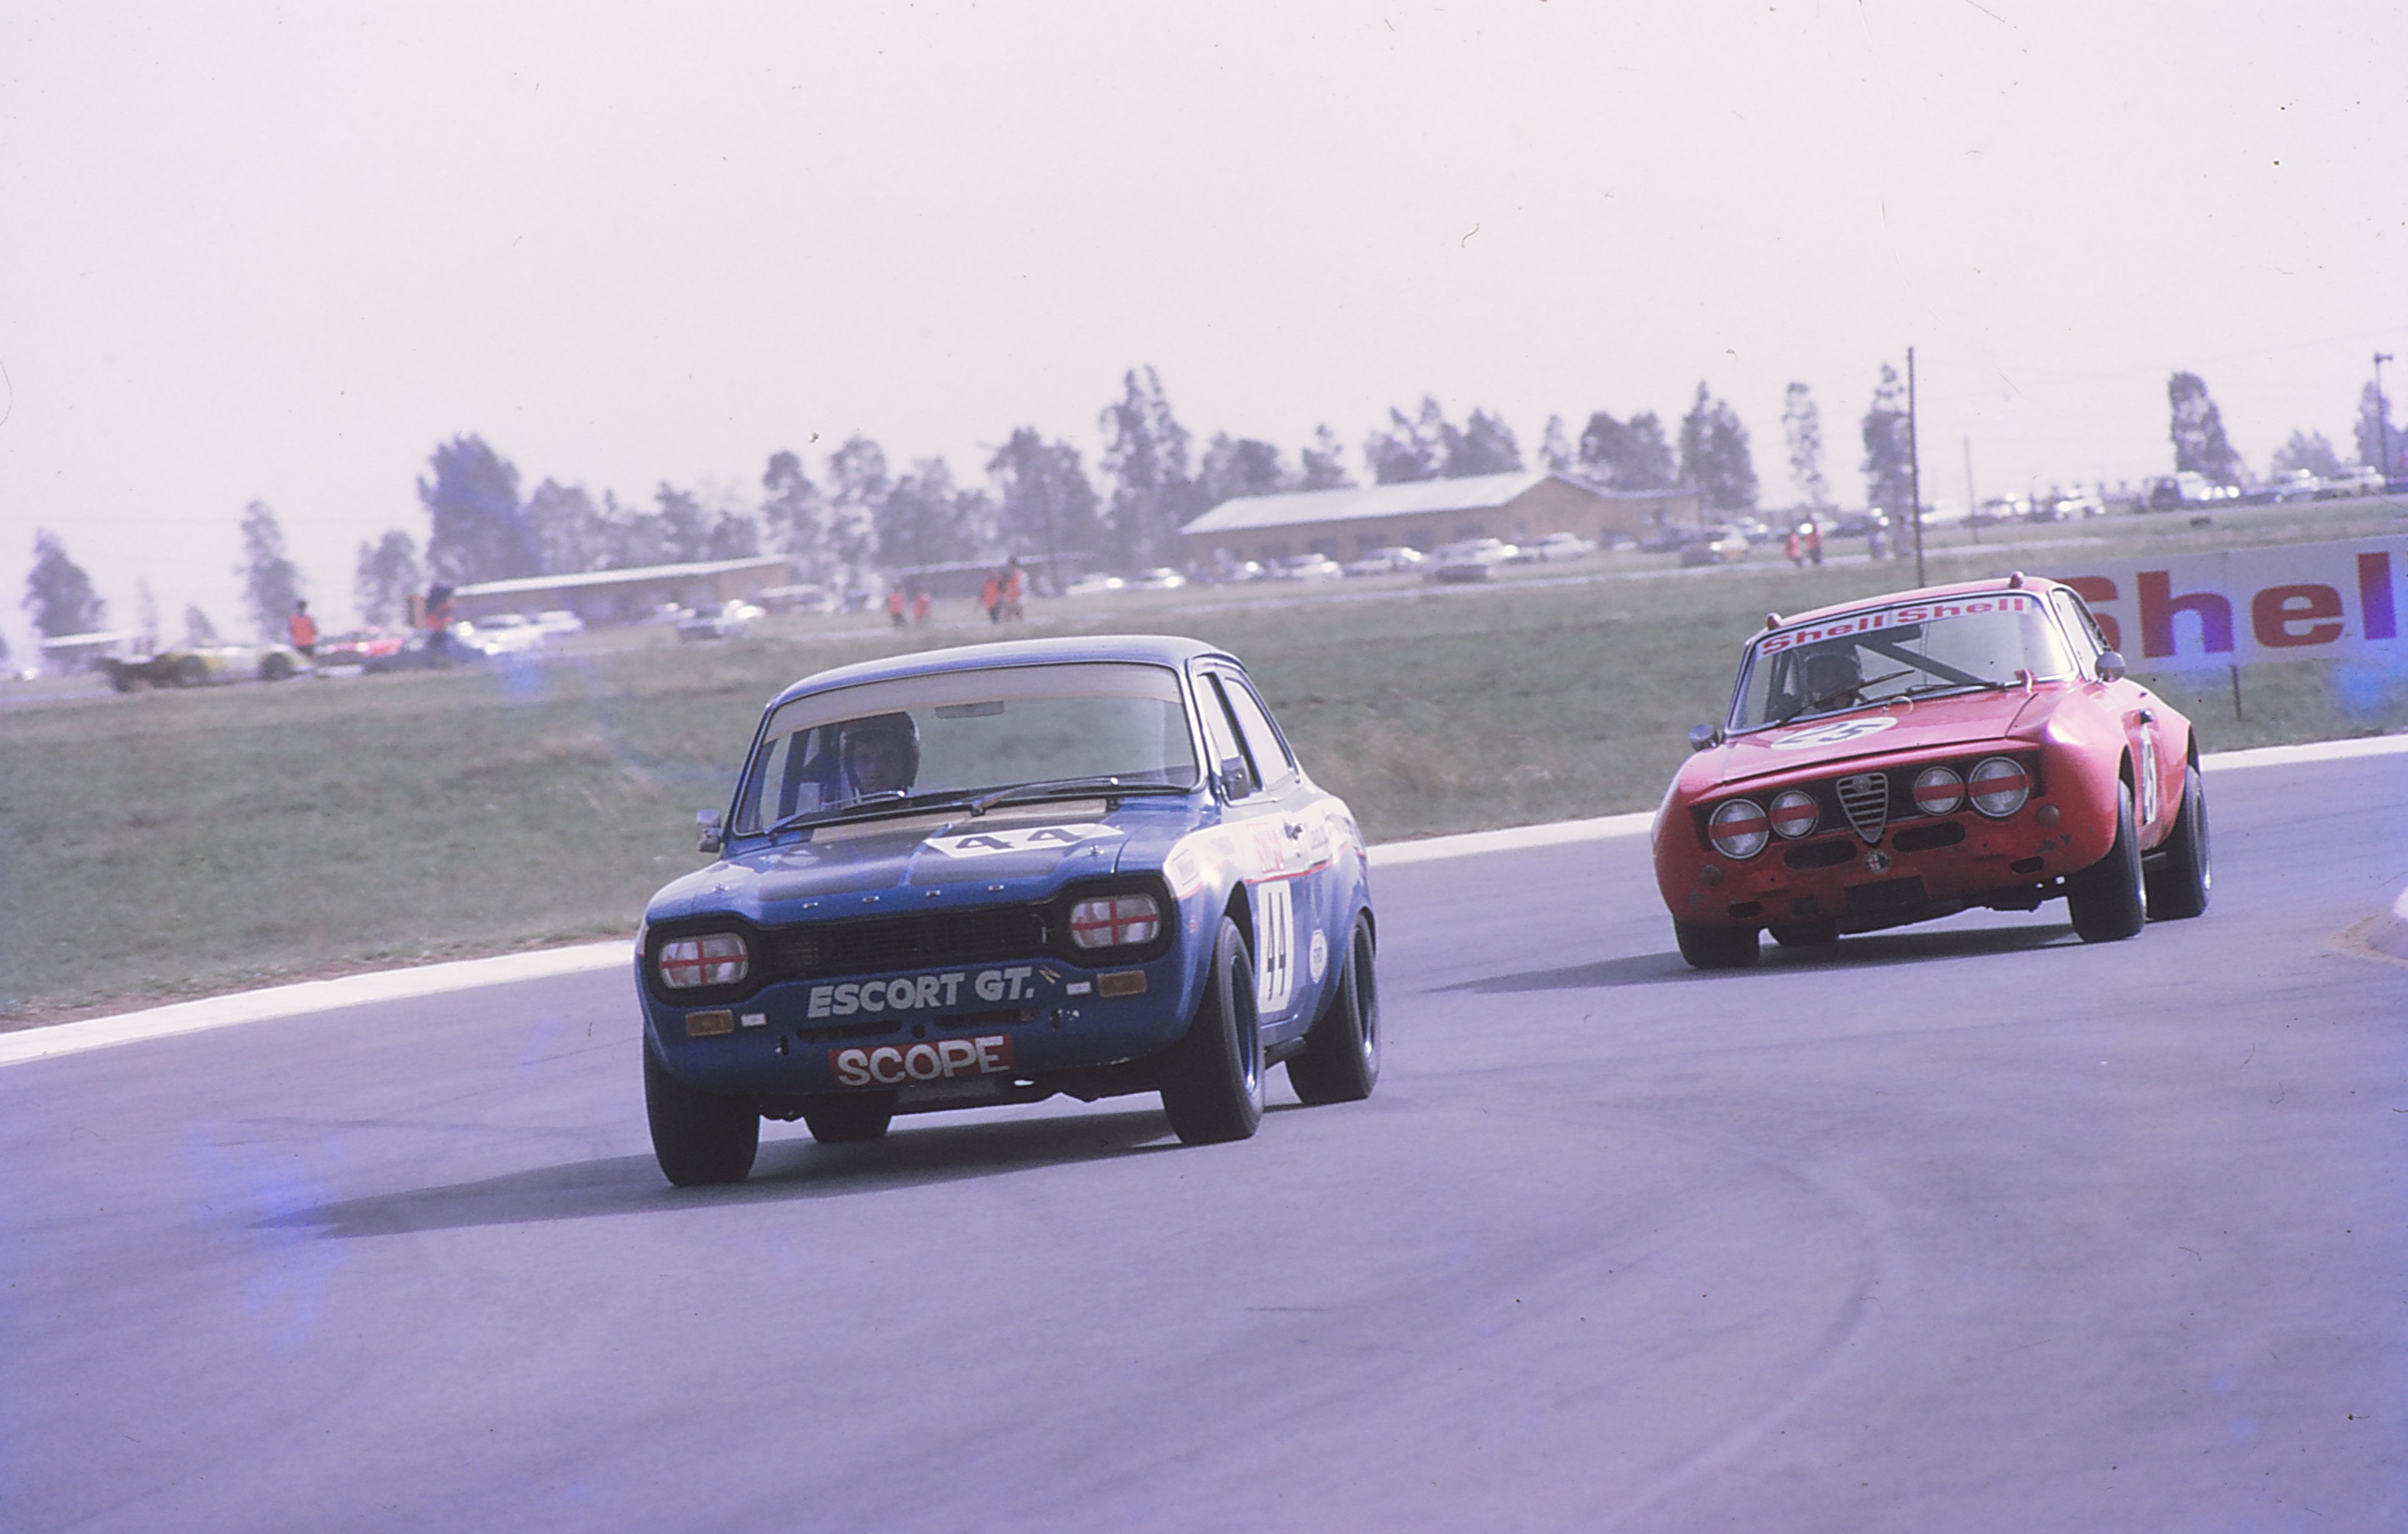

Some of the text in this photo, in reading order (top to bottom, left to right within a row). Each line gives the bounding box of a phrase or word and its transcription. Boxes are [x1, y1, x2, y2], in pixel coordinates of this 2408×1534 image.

[1762, 598, 2023, 655] Shell Shell
[956, 829, 1086, 850] 44
[1267, 891, 1287, 1001] 44
[807, 966, 1035, 1018] ESCORT GT.
[837, 1036, 1011, 1087] SCOPE
